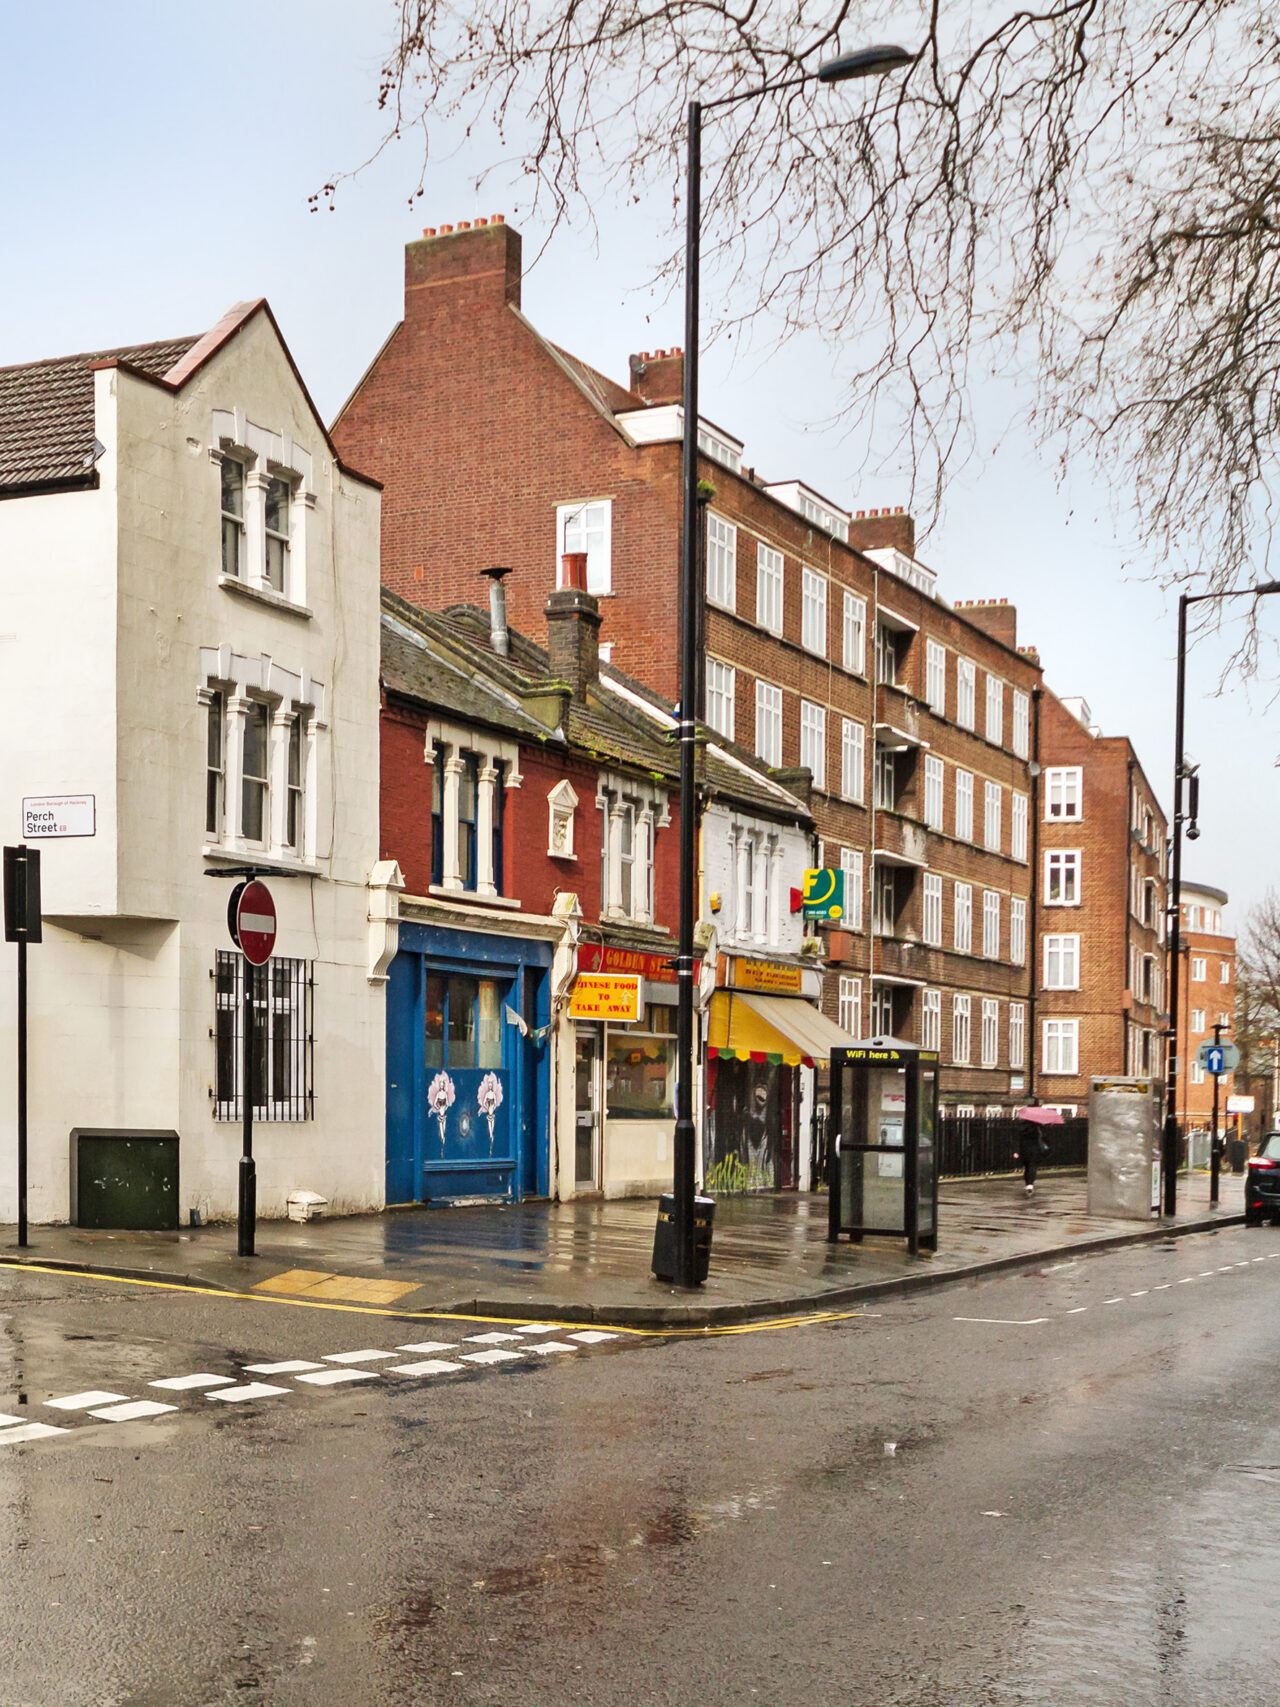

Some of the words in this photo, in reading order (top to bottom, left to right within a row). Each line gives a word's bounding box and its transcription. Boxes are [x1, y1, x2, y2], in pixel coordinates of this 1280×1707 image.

[26, 811, 54, 821] Perch
[27, 822, 58, 833] Street
[606, 950, 644, 970] GOLDEN
[614, 982, 638, 990] FOOD
[576, 1004, 600, 1012] TAKE
[608, 1004, 631, 1013] AWAY
[846, 1050, 866, 1058] WiFi
[869, 1050, 888, 1059] here
